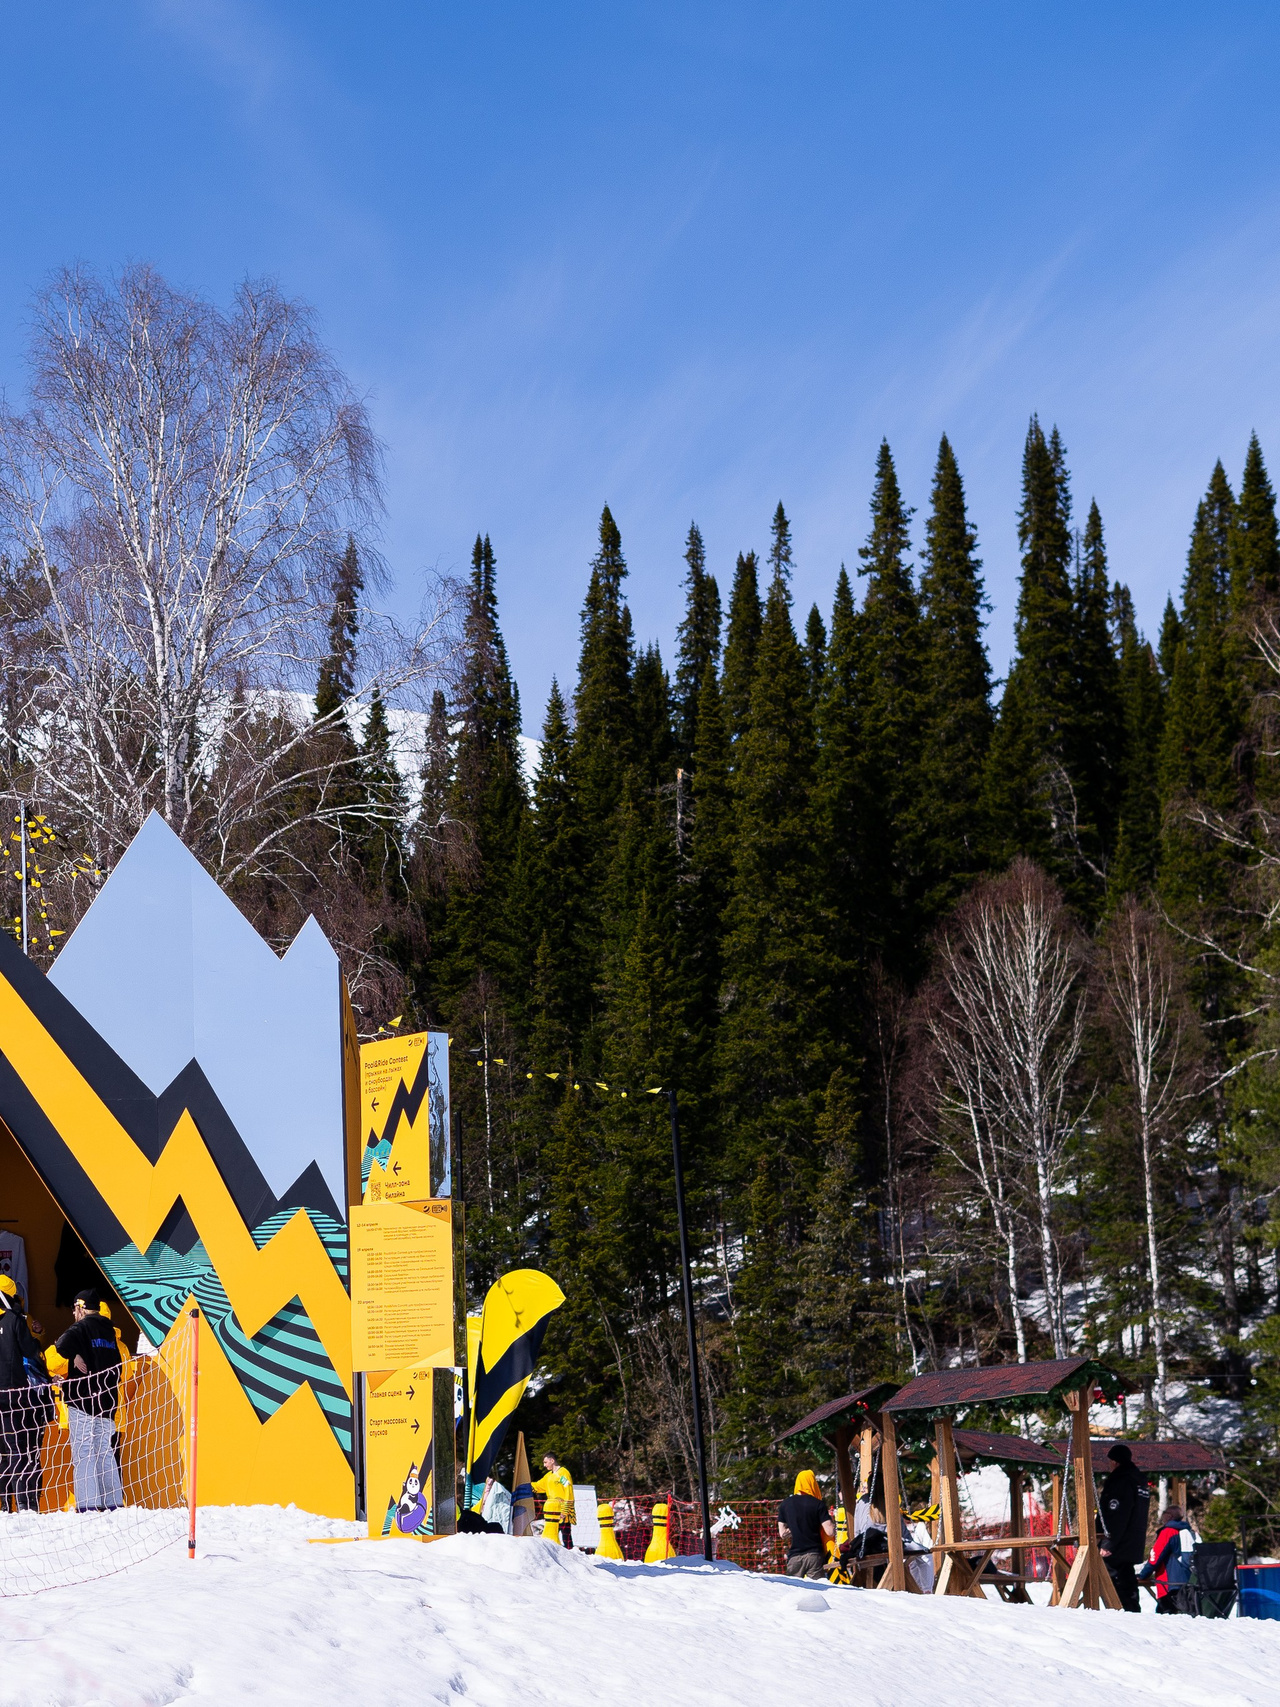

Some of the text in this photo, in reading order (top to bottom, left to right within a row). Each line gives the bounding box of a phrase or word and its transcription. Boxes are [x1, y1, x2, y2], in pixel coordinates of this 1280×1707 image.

[389, 1055, 408, 1065] Contest
[369, 1419, 383, 1427] Старт
[369, 1430, 388, 1438] спусков
